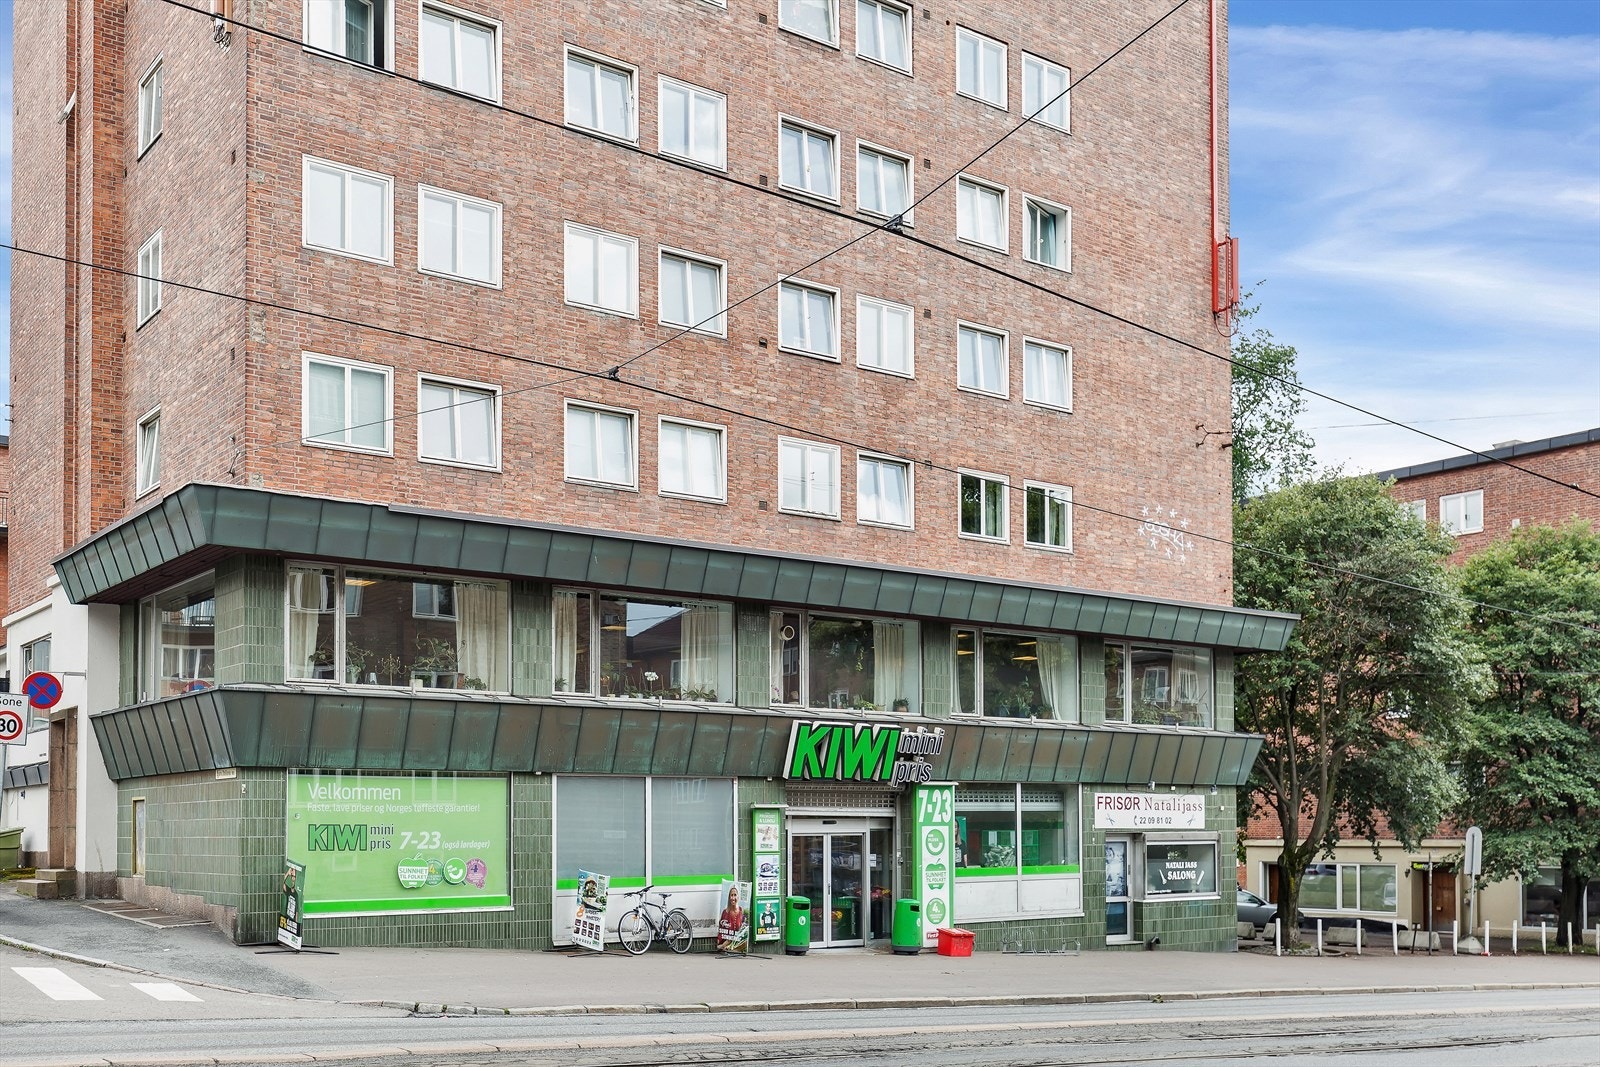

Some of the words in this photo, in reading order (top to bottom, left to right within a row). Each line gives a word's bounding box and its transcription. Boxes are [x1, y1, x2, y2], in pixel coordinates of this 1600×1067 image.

[0, 695, 22, 706] one
[784, 720, 902, 781] KIWI
[899, 728, 945, 755] mini
[891, 756, 933, 787] pris
[307, 782, 401, 800] Velkommen
[307, 803, 332, 813] Faste,
[333, 803, 350, 812] lave
[351, 803, 373, 814] priser
[374, 805, 384, 814] og
[385, 803, 412, 814] Norges
[413, 803, 444, 813] tøffeste
[444, 803, 480, 814] garantier!
[918, 789, 951, 823] 7-23
[1097, 796, 1141, 811] FRISØR
[1144, 797, 1203, 814] Natalijass
[370, 824, 394, 835] mini
[1139, 816, 1147, 825] 22
[1148, 816, 1155, 825] 09
[1157, 816, 1164, 825] 81
[1165, 816, 1172, 825] 02
[308, 824, 367, 851] KIWI
[370, 837, 391, 851] pris
[399, 831, 441, 850] 7-23
[442, 840, 460, 851] (også
[461, 840, 491, 850] lørdager)
[1167, 870, 1197, 880] SALONG
